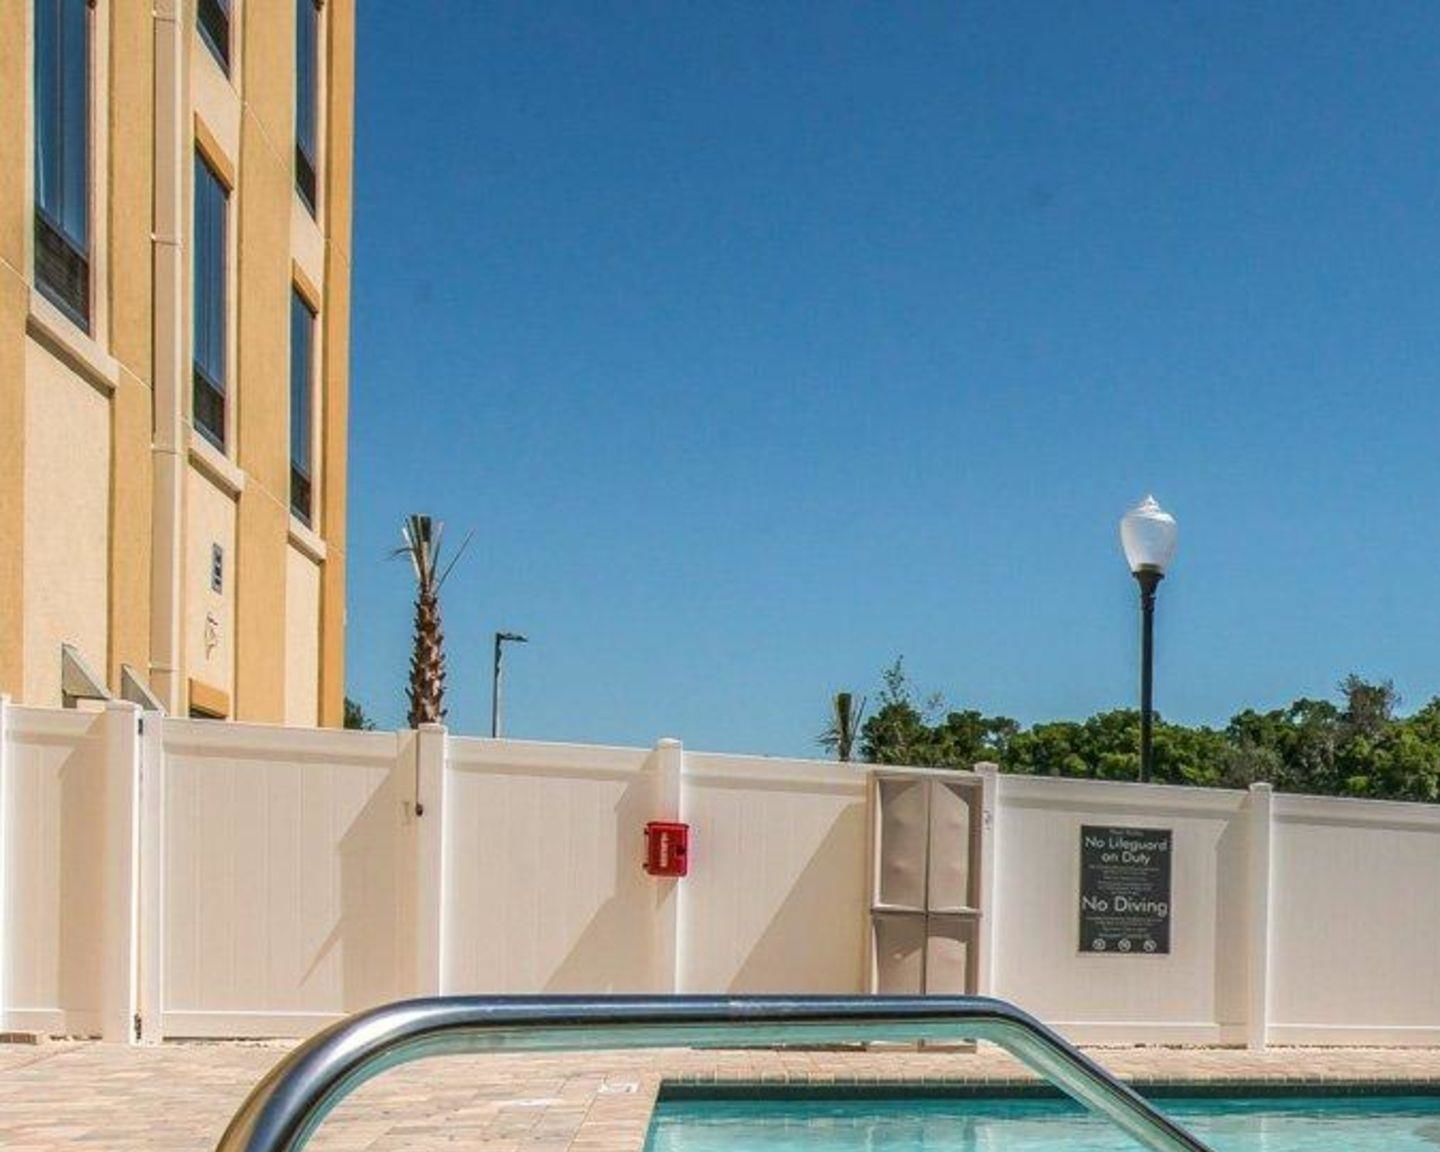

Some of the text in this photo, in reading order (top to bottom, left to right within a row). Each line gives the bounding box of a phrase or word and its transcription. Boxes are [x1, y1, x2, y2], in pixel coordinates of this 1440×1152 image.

[1085, 836, 1167, 852] No Lifeguard
[1101, 851, 1151, 865] on Duty
[1083, 896, 1168, 918] No Diving
